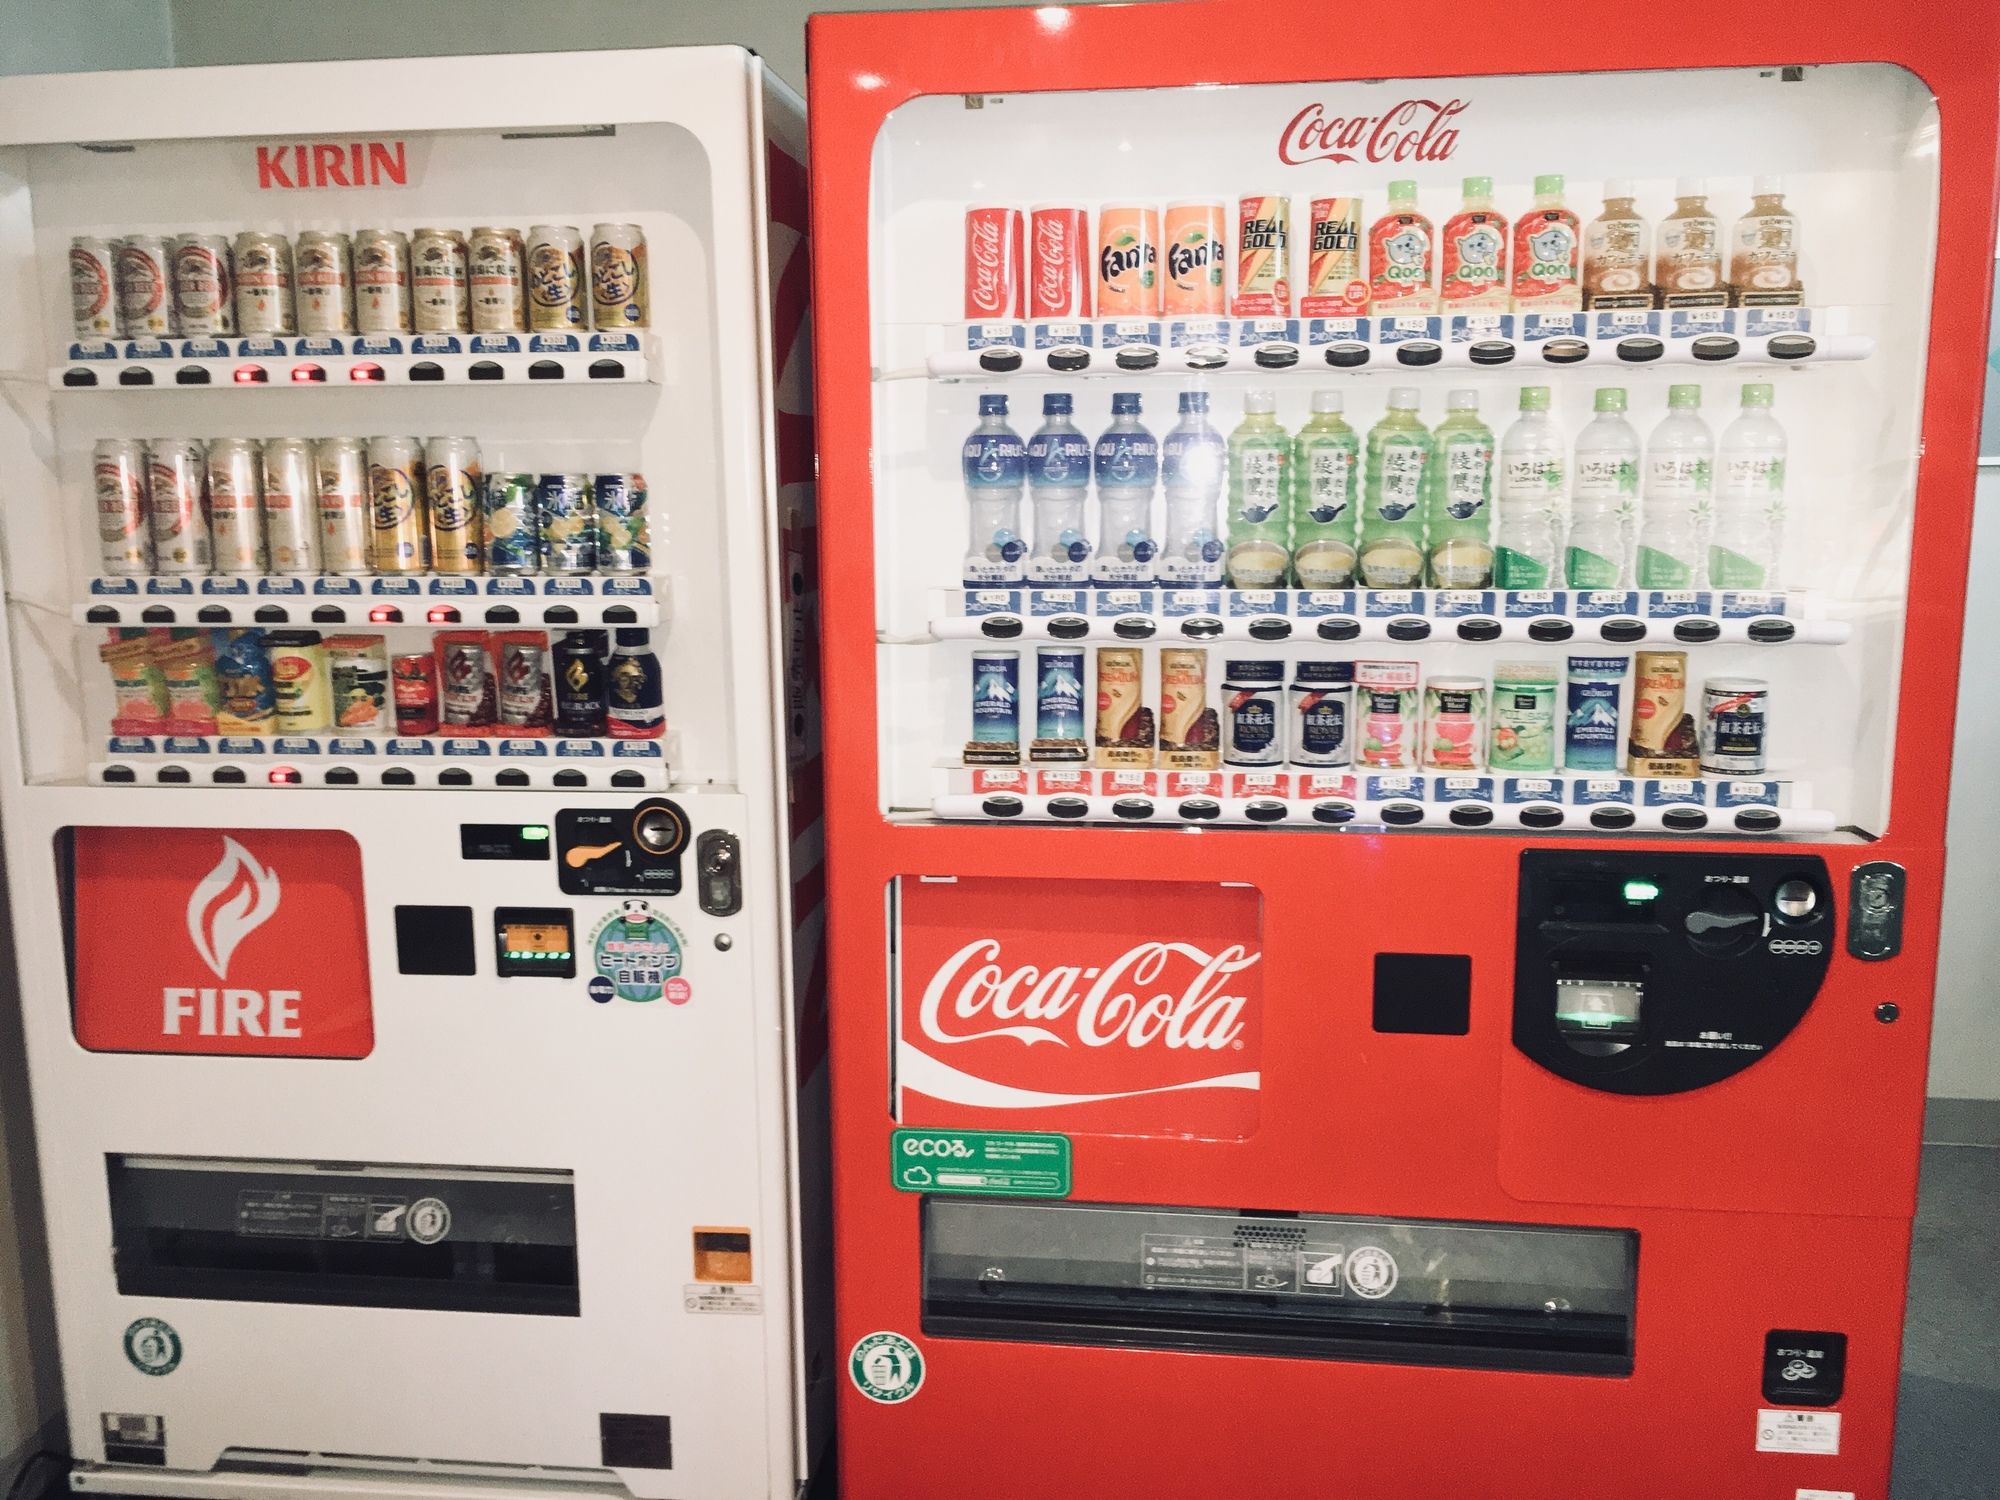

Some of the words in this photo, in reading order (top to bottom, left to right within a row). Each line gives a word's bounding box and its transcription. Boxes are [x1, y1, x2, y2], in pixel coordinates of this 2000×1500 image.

[1278, 98, 1473, 165] Coca-Cola
[256, 142, 407, 188] KIRIN
[1244, 218, 1286, 234] REAL
[1315, 219, 1357, 235] REAL
[1243, 234, 1286, 250] GOLD
[1313, 234, 1357, 251] GOLD
[973, 220, 999, 310] Coca-Cola
[1038, 217, 1064, 309] Coca-Cola
[1531, 263, 1567, 277] Qoo
[1388, 265, 1423, 279] Qoo
[1459, 265, 1494, 279] Qoo
[920, 938, 1261, 1050] Coca-Cola
[163, 987, 302, 1038] FIRE
